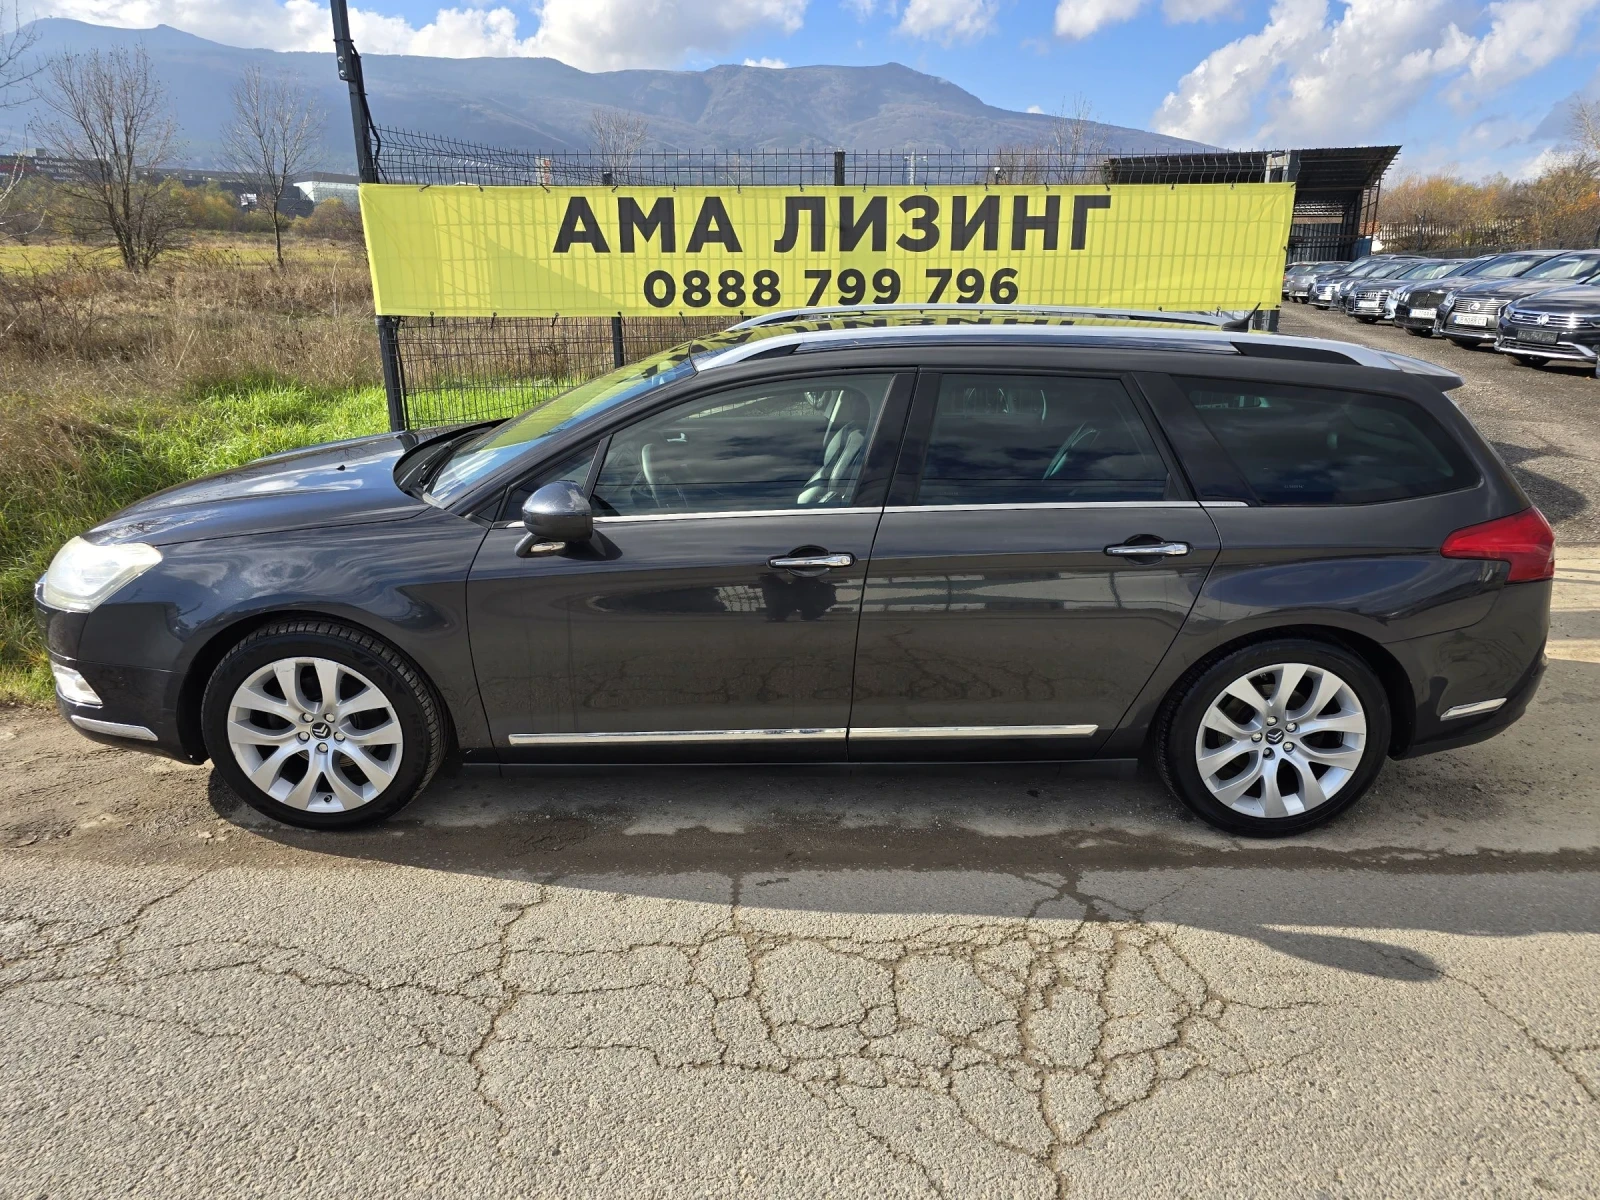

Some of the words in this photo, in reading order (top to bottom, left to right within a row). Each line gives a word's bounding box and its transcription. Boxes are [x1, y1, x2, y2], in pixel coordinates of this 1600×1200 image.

[552, 196, 743, 253] АМА
[773, 195, 1112, 253] ЛИЗИНГ
[643, 269, 782, 308] 0888
[804, 268, 901, 307] 799
[925, 267, 1019, 305] 796
